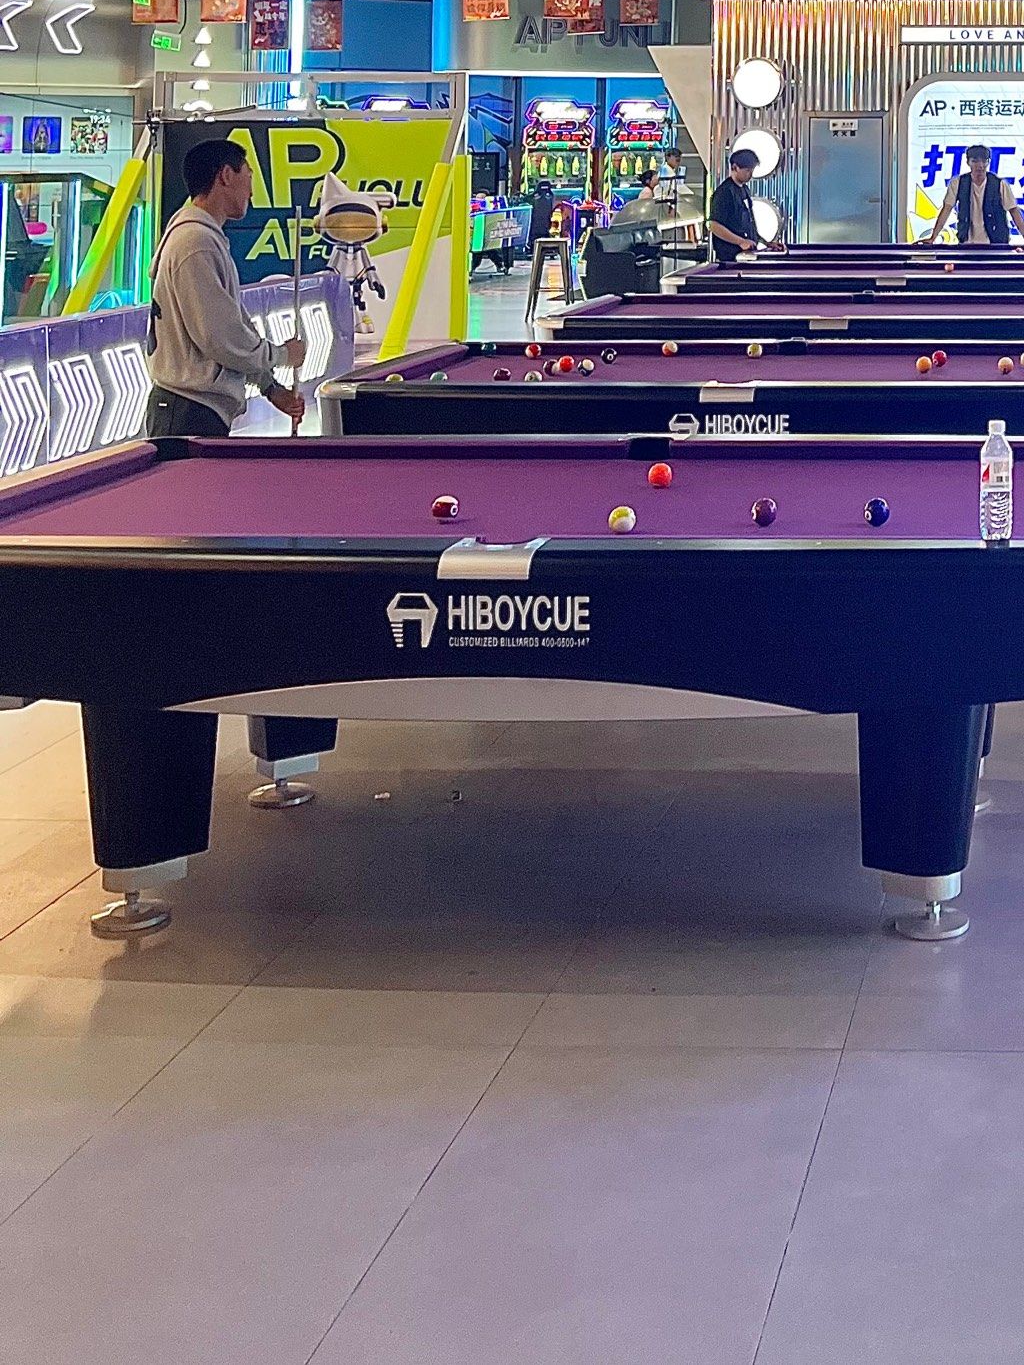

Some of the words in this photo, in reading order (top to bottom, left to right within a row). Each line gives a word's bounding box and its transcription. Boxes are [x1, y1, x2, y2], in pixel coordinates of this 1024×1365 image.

[949, 29, 995, 41] LOVE
[704, 414, 790, 435] HIBOYCUE
[447, 594, 591, 632] HIBOYCUE
[448, 636, 499, 648] CUSTOMIZED
[500, 636, 540, 648] BILLIARDS
